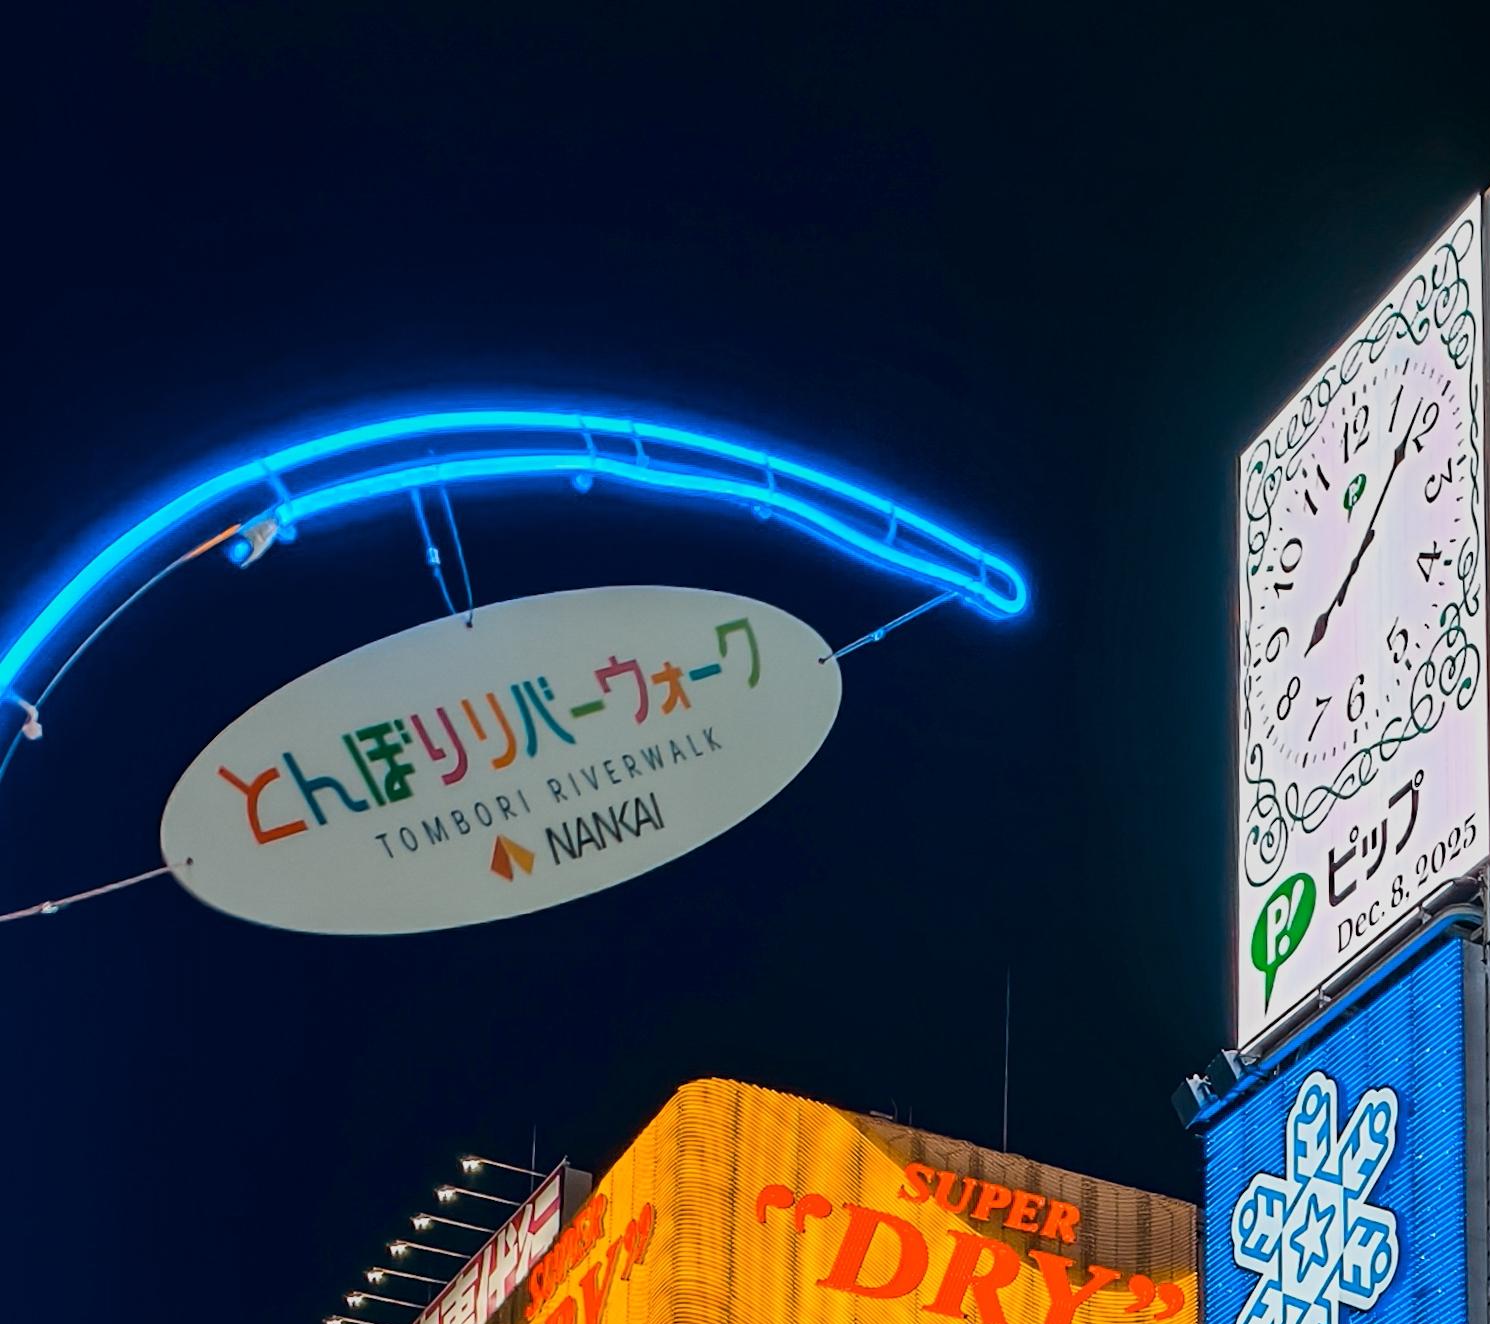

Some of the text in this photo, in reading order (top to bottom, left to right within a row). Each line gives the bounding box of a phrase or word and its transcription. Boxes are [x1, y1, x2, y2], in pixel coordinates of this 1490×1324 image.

[1343, 405, 1369, 463] 12
[1389, 385, 1403, 432] 1
[1413, 402, 1440, 453] 2
[1304, 464, 1330, 515] 11
[1425, 459, 1453, 503] 3
[1274, 538, 1303, 598] 10
[1417, 541, 1443, 582] 4
[1266, 627, 1289, 663] 9
[1387, 616, 1409, 664] 5
[1277, 677, 1300, 720] 8
[1308, 697, 1332, 741] 7
[1347, 674, 1365, 722] 6
[219, 617, 762, 844] とんぼりリバーウォーク
[375, 727, 723, 859] TOMBORI RIVERWALK
[547, 793, 665, 865] NANKAI
[1328, 770, 1424, 907] ピップ
[1337, 895, 1386, 953] Dec.
[1416, 814, 1477, 887] 2025
[899, 1163, 1080, 1243] SUPER
[525, 1193, 607, 1320] SUPER
